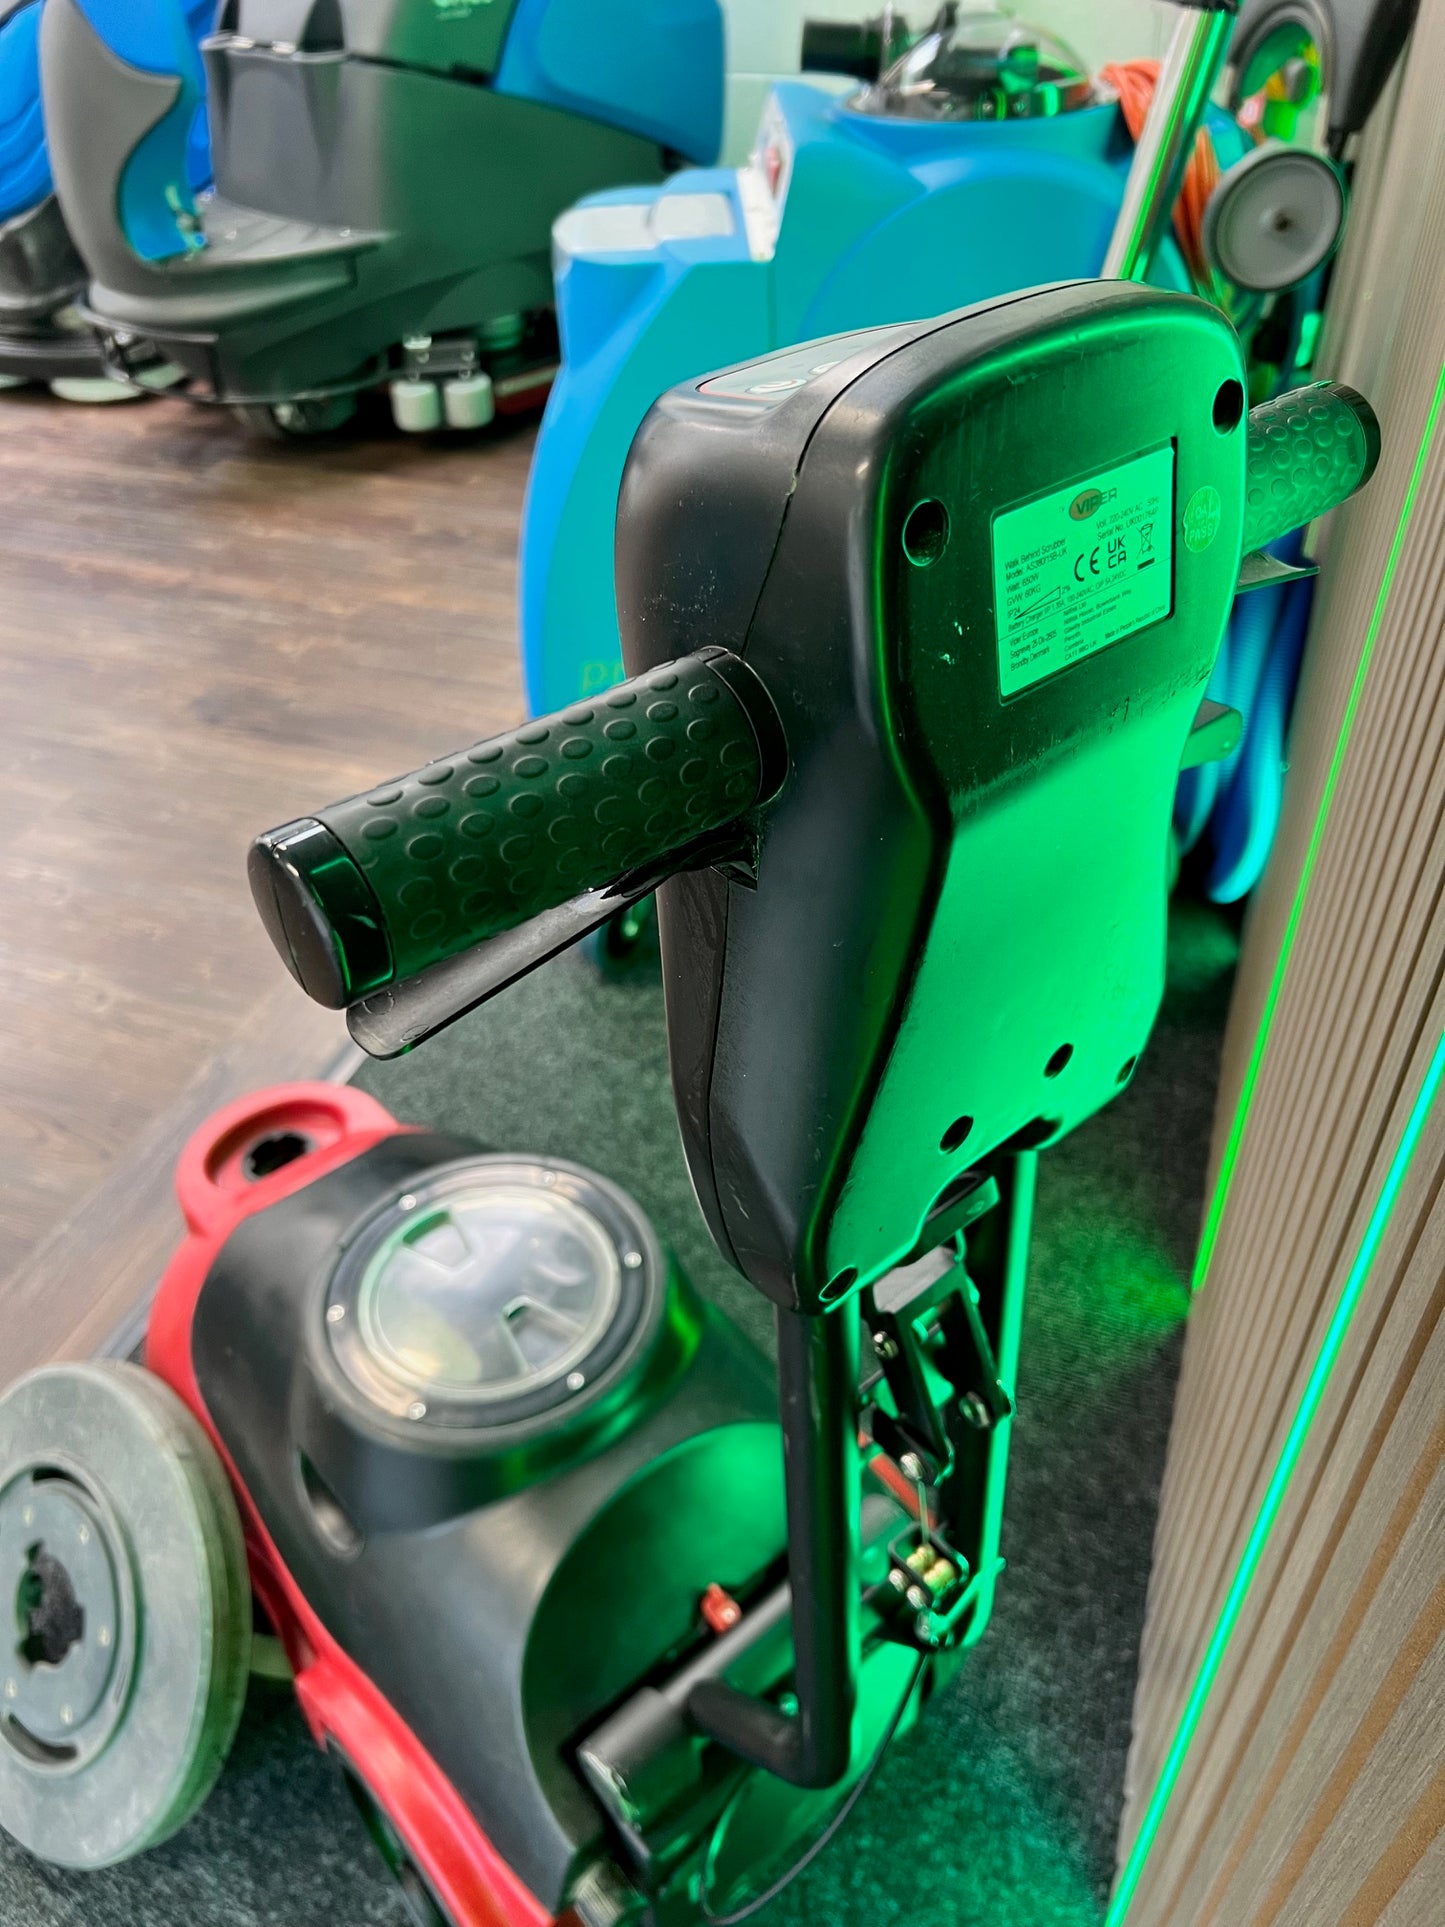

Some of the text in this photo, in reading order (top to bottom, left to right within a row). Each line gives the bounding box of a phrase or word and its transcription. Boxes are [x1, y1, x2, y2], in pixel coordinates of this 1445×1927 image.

[1076, 487, 1117, 515] VIPER
[1098, 527, 1113, 541] Serial
[1190, 523, 1213, 543] PASS
[1021, 549, 1040, 564] Behind
[1042, 537, 1066, 555] Scrubber
[1107, 534, 1126, 553] UK
[1107, 550, 1127, 569] CA
[1008, 607, 1020, 619] IP24
